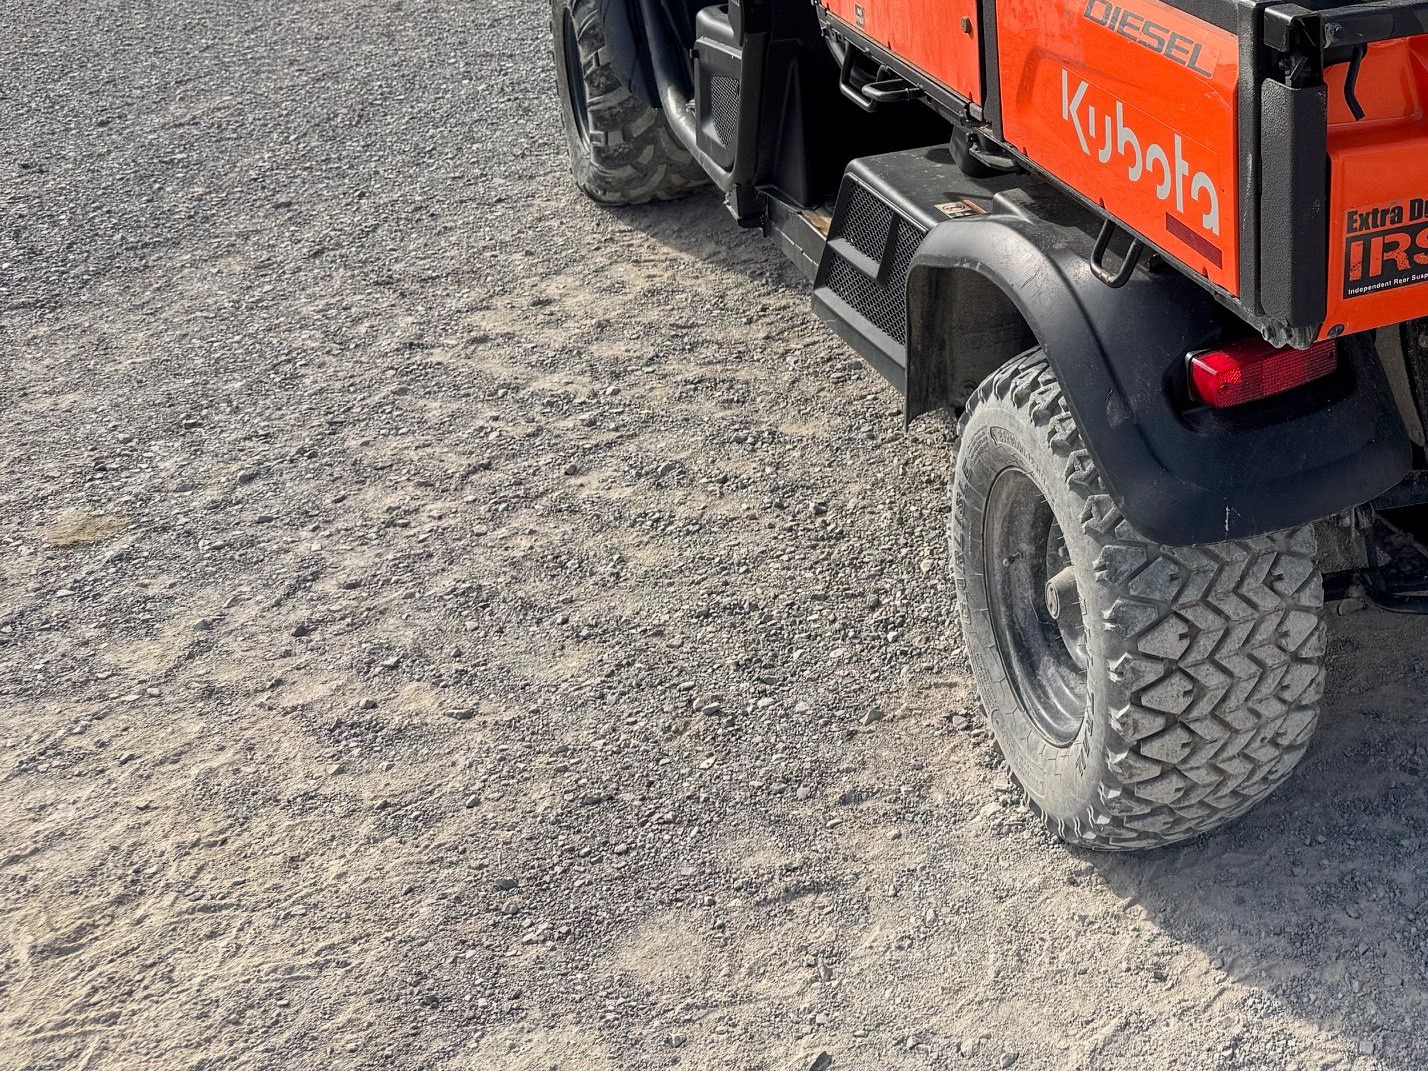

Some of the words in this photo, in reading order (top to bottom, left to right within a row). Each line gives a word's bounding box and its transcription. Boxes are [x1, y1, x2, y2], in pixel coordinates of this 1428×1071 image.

[1062, 68, 1220, 237] Kubota
[1347, 205, 1404, 235] Extra
[1348, 279, 1392, 295] Independent
[1393, 276, 1410, 285] Rear
